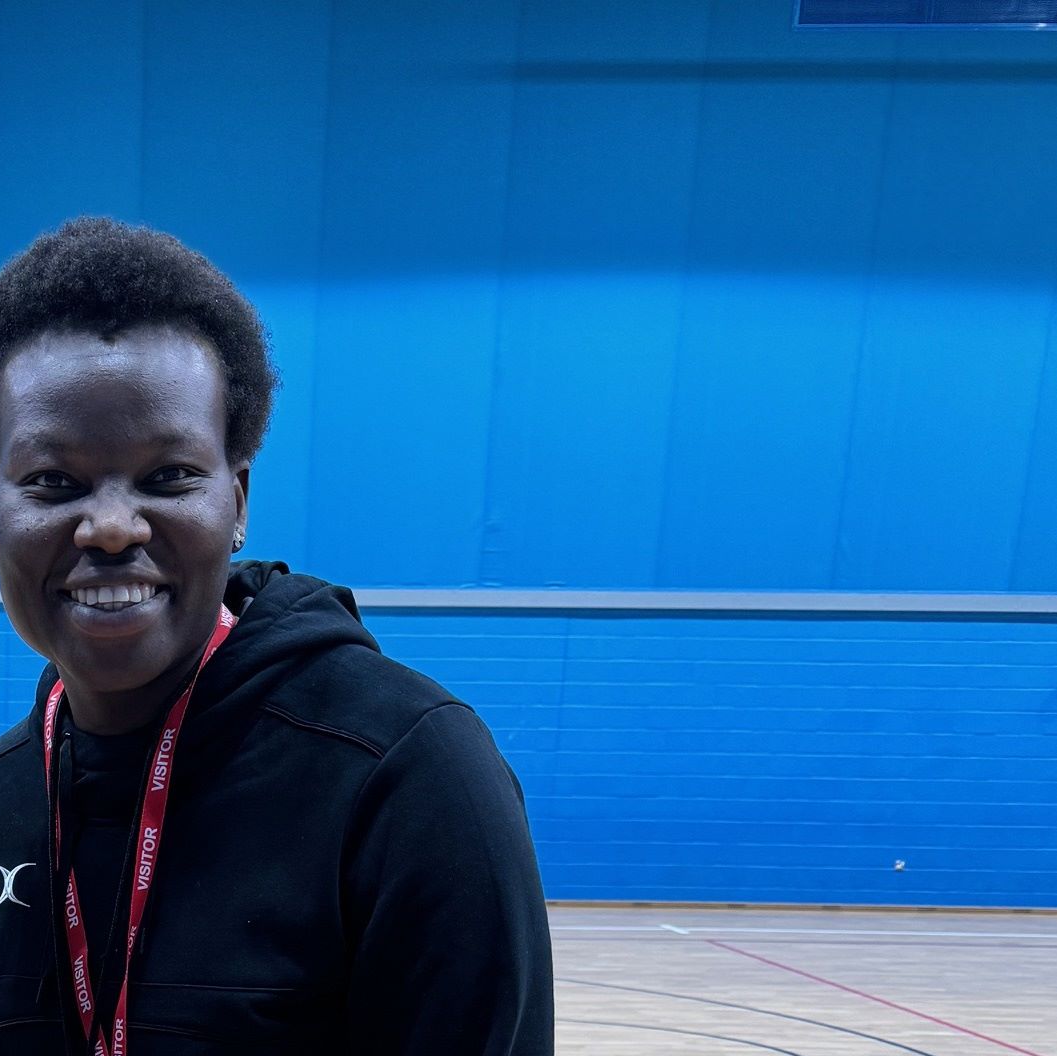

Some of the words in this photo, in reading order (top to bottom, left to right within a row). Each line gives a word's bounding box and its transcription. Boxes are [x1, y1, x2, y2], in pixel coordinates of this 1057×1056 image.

[151, 728, 177, 792] VISITOR
[137, 827, 158, 891] VISITOR
[65, 876, 79, 929] SITOR
[73, 954, 92, 1014] VISITOR
